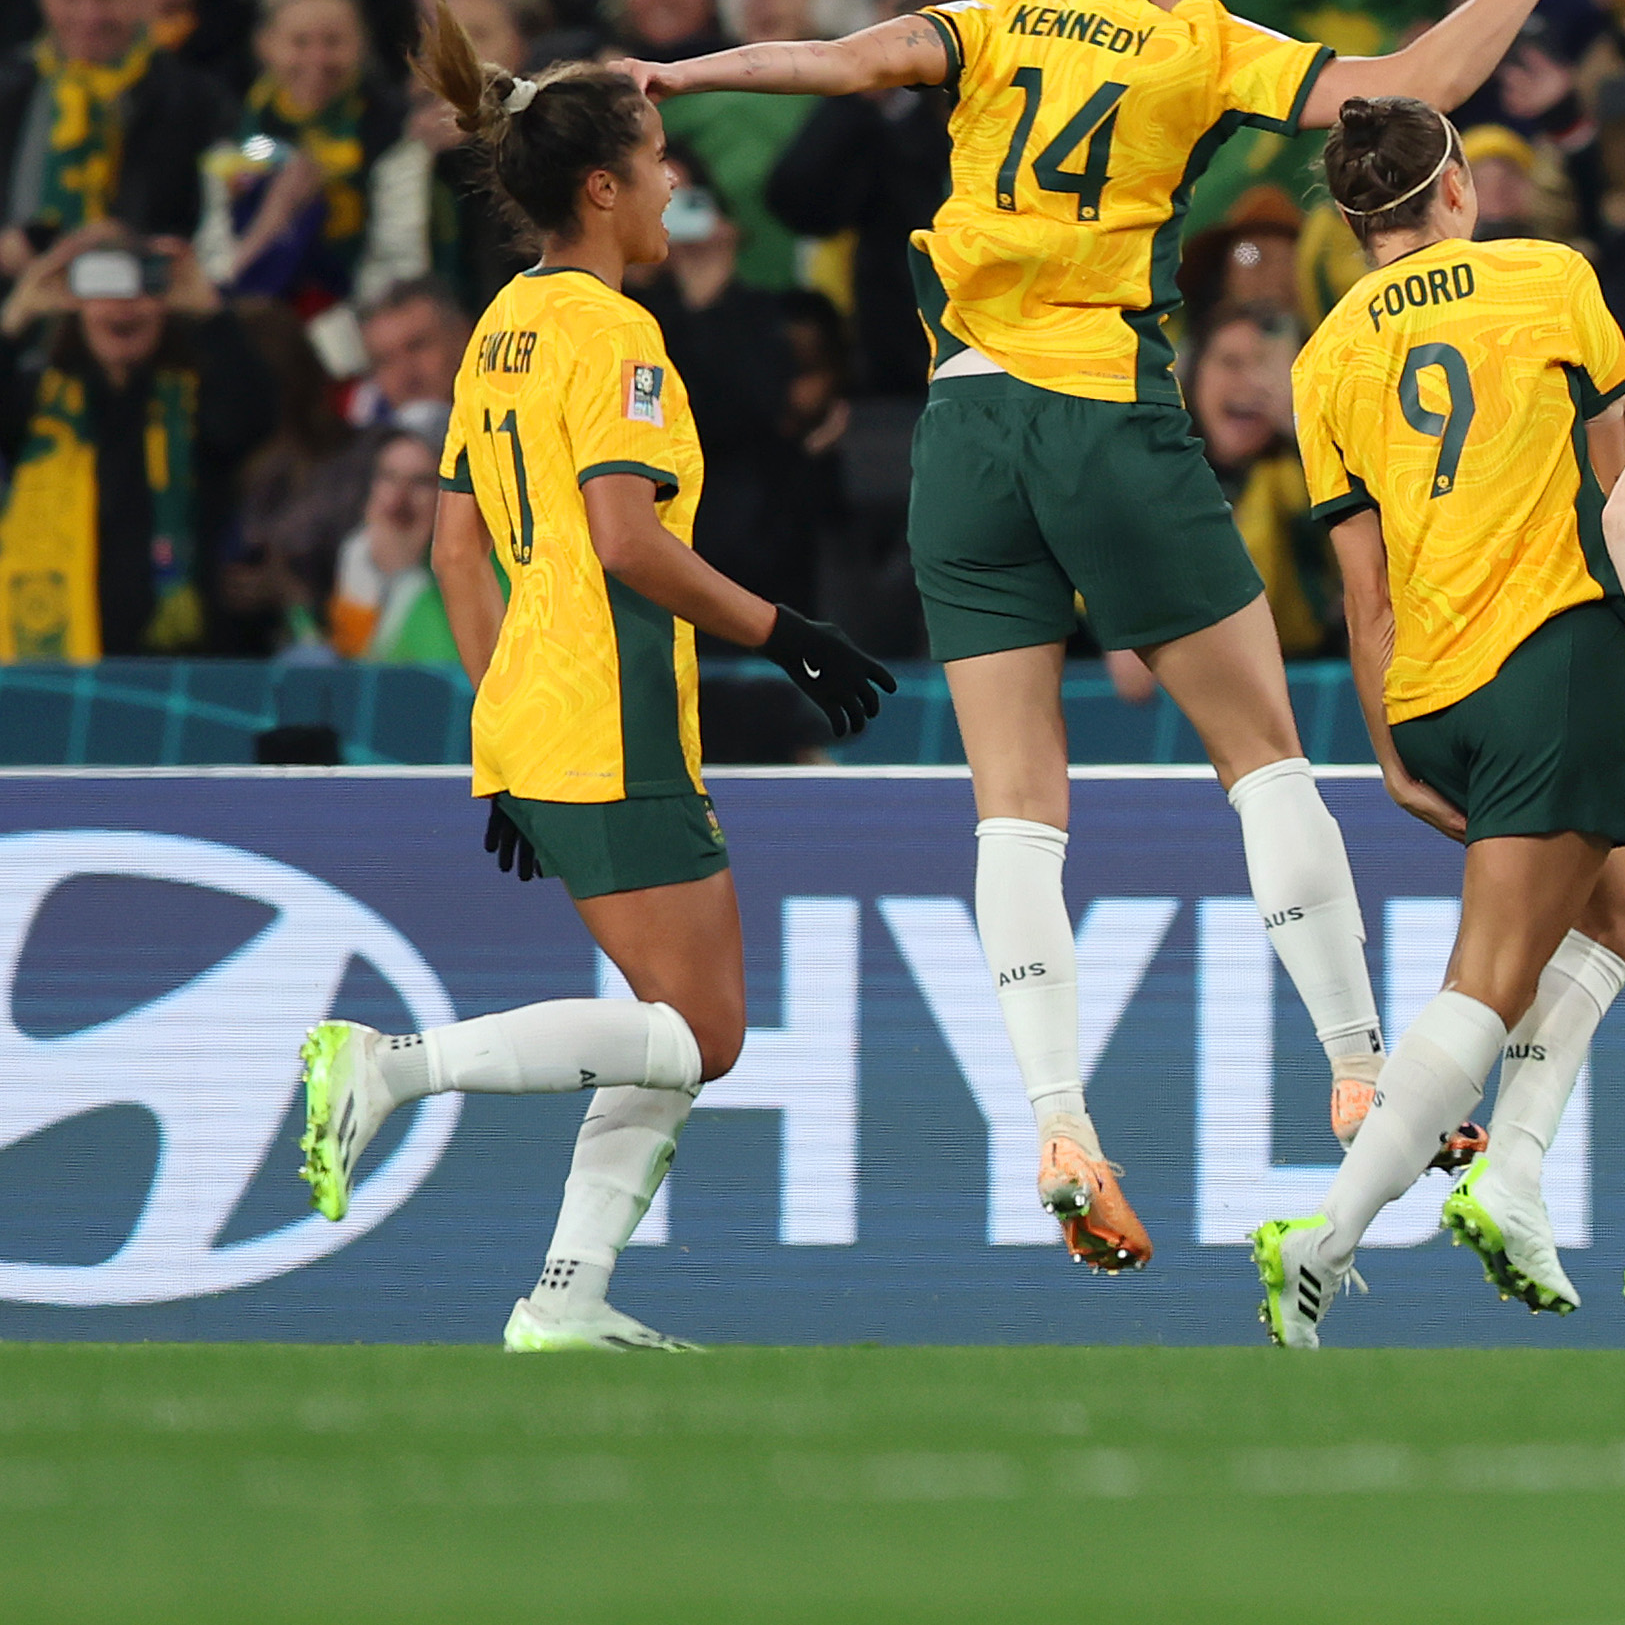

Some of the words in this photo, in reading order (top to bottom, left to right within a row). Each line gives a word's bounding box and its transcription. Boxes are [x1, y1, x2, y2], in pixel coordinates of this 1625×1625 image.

[1008, 4, 1157, 57] KENNEDY
[996, 66, 1130, 222] 14
[1368, 262, 1475, 334] FOORD
[1397, 342, 1476, 500] 9
[483, 407, 535, 565] 11
[999, 962, 1047, 987] AUS
[1505, 1043, 1547, 1062] AUS
